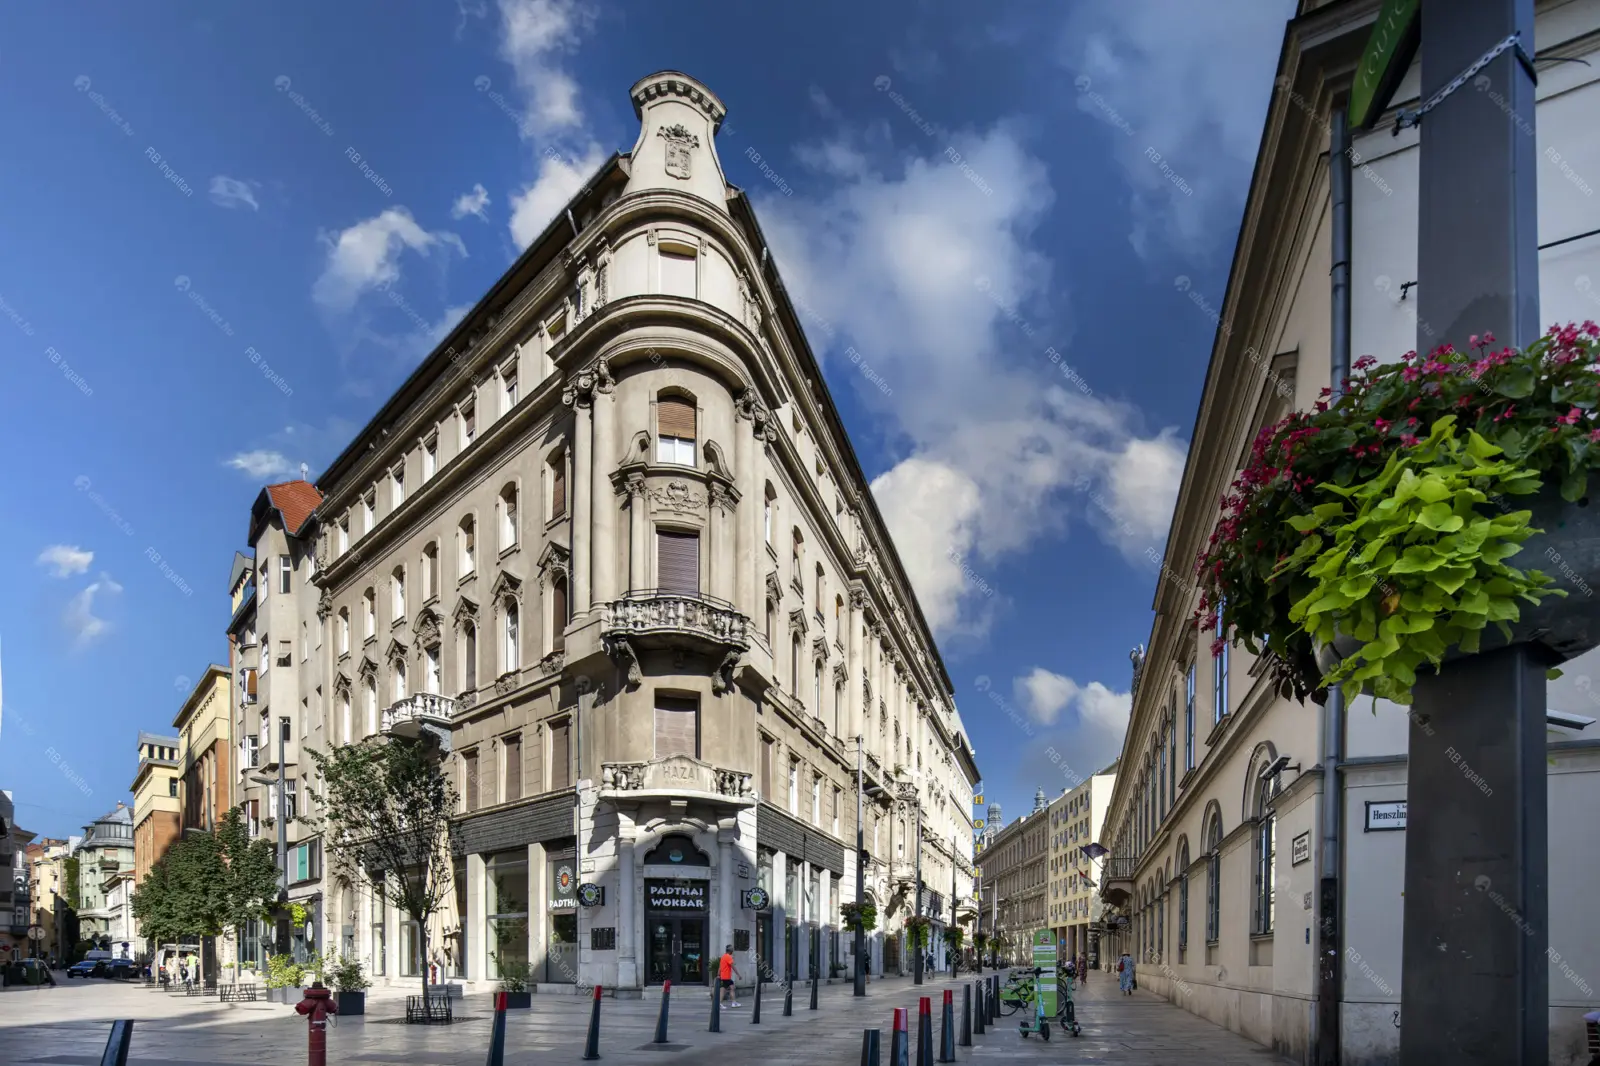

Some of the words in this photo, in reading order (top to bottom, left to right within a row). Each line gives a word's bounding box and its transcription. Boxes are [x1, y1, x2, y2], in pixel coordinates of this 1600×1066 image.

[662, 766, 700, 781] HAZAI
[1373, 809, 1407, 820] Henszlm
[650, 886, 704, 896] PADTHAI
[651, 898, 704, 908] WOKBAR
